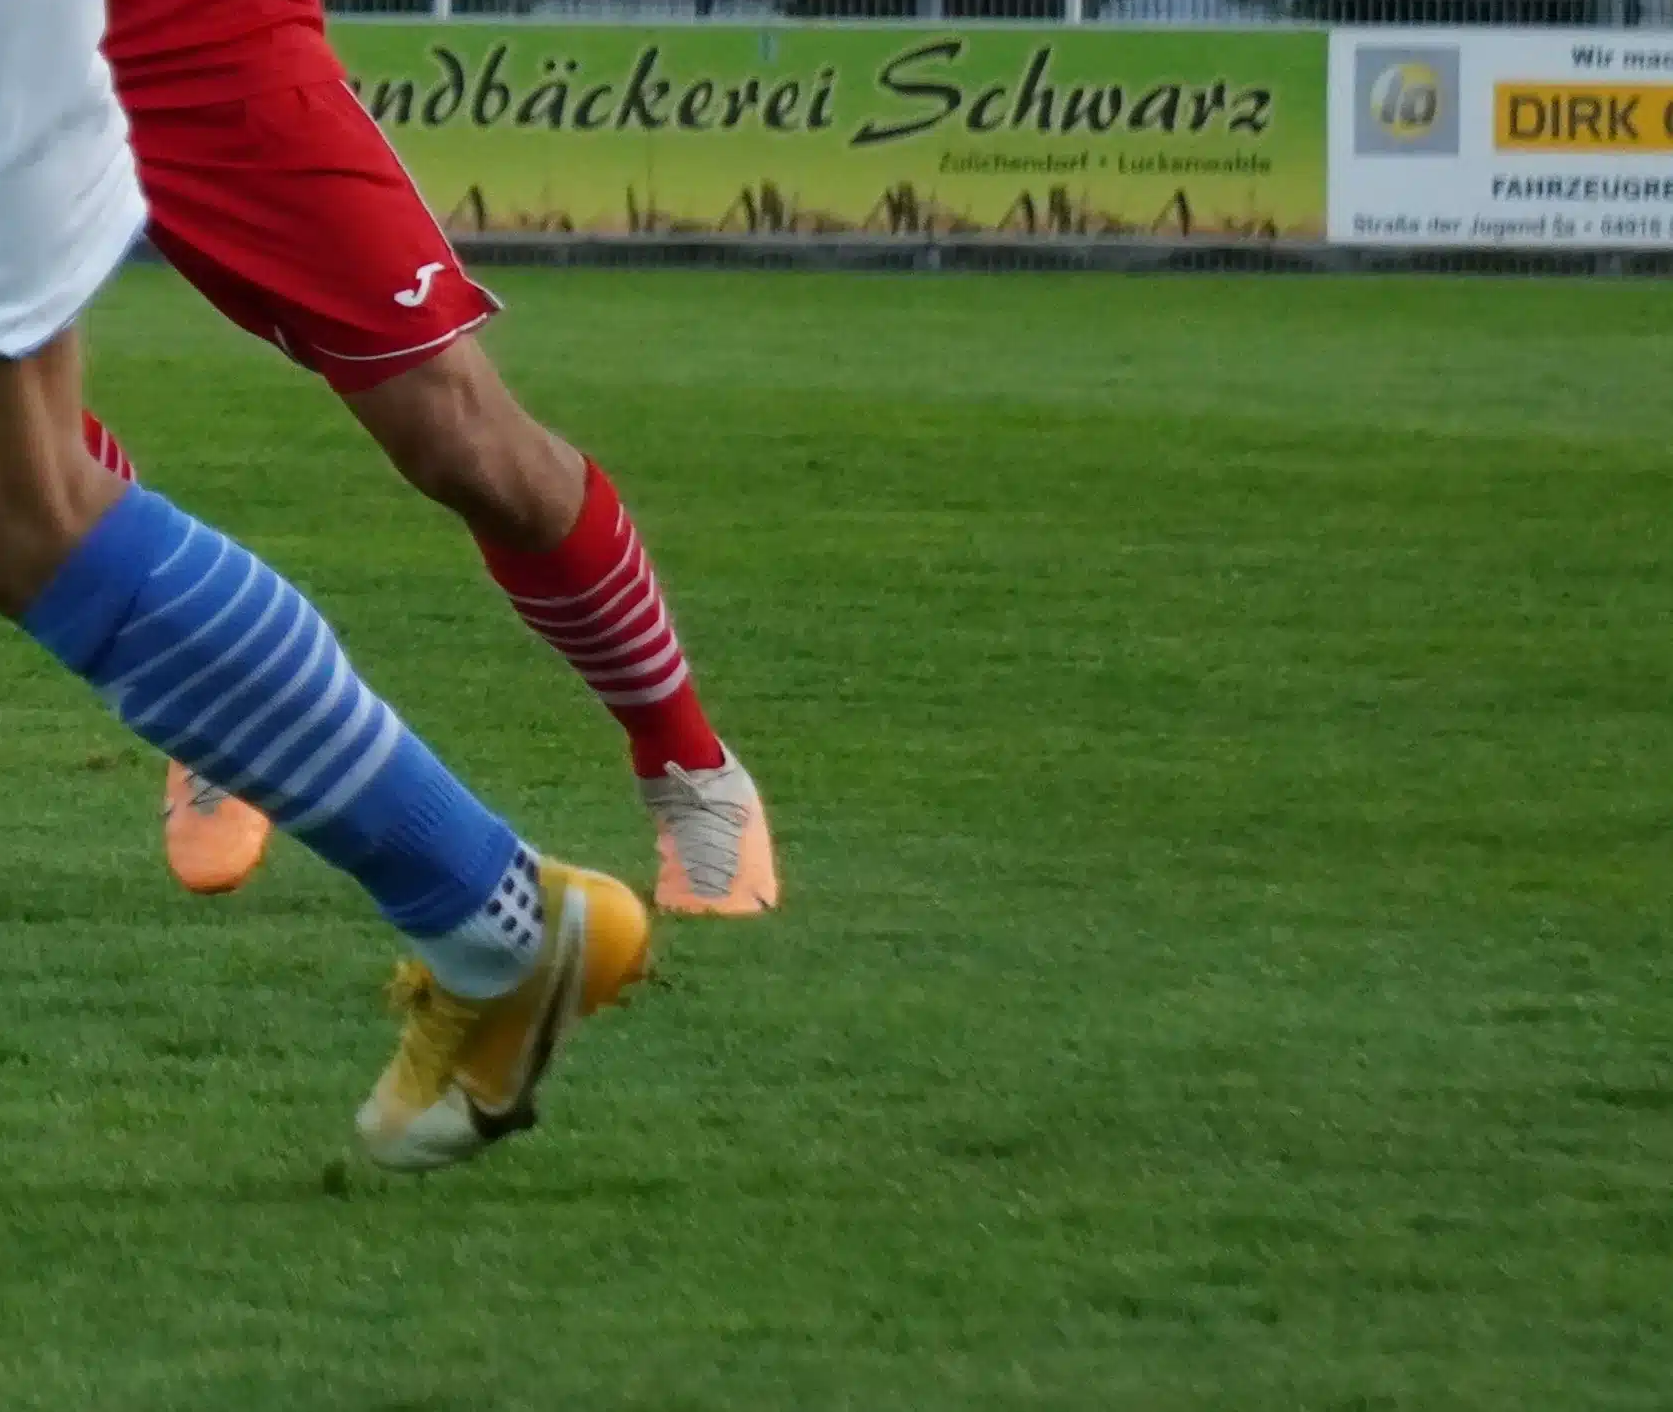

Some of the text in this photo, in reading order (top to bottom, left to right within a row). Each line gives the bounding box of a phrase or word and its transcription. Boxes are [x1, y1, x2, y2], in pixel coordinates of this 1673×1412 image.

[354, 37, 1274, 148] ndbäckerei Schwarz
[1509, 92, 1641, 143] DIRK
